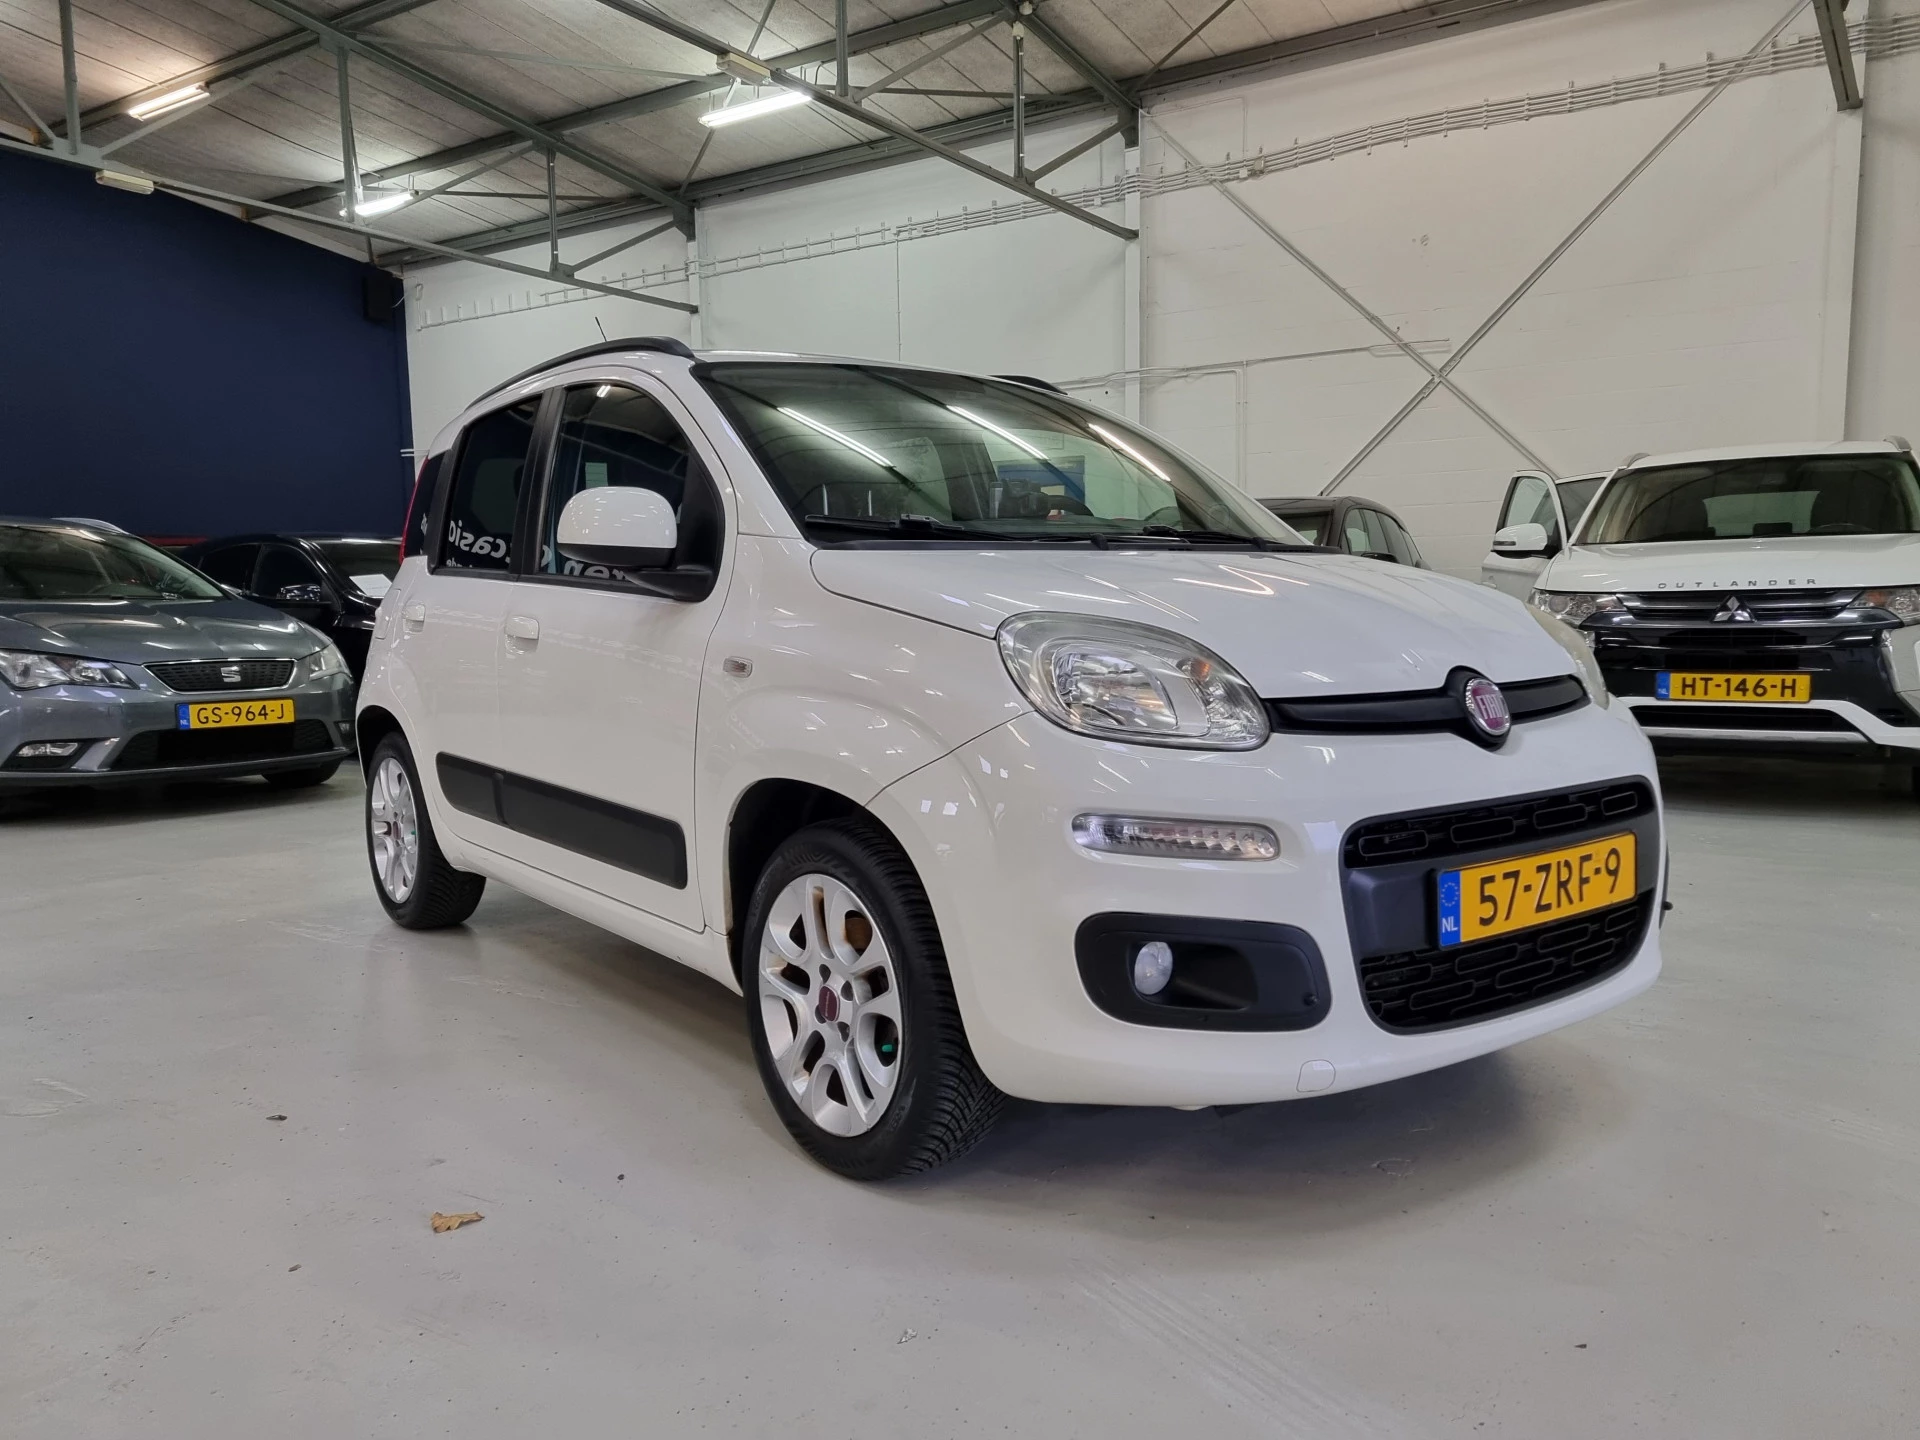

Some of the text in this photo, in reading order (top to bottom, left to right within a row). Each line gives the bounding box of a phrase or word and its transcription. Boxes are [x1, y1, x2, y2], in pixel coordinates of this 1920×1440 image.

[1657, 578, 1816, 589] OUTLANDER
[1681, 676, 1797, 697] HT-146-H
[196, 703, 284, 725] GS-964-J
[1479, 847, 1621, 927] 57-ZRF-9
[1442, 915, 1458, 933] NL
